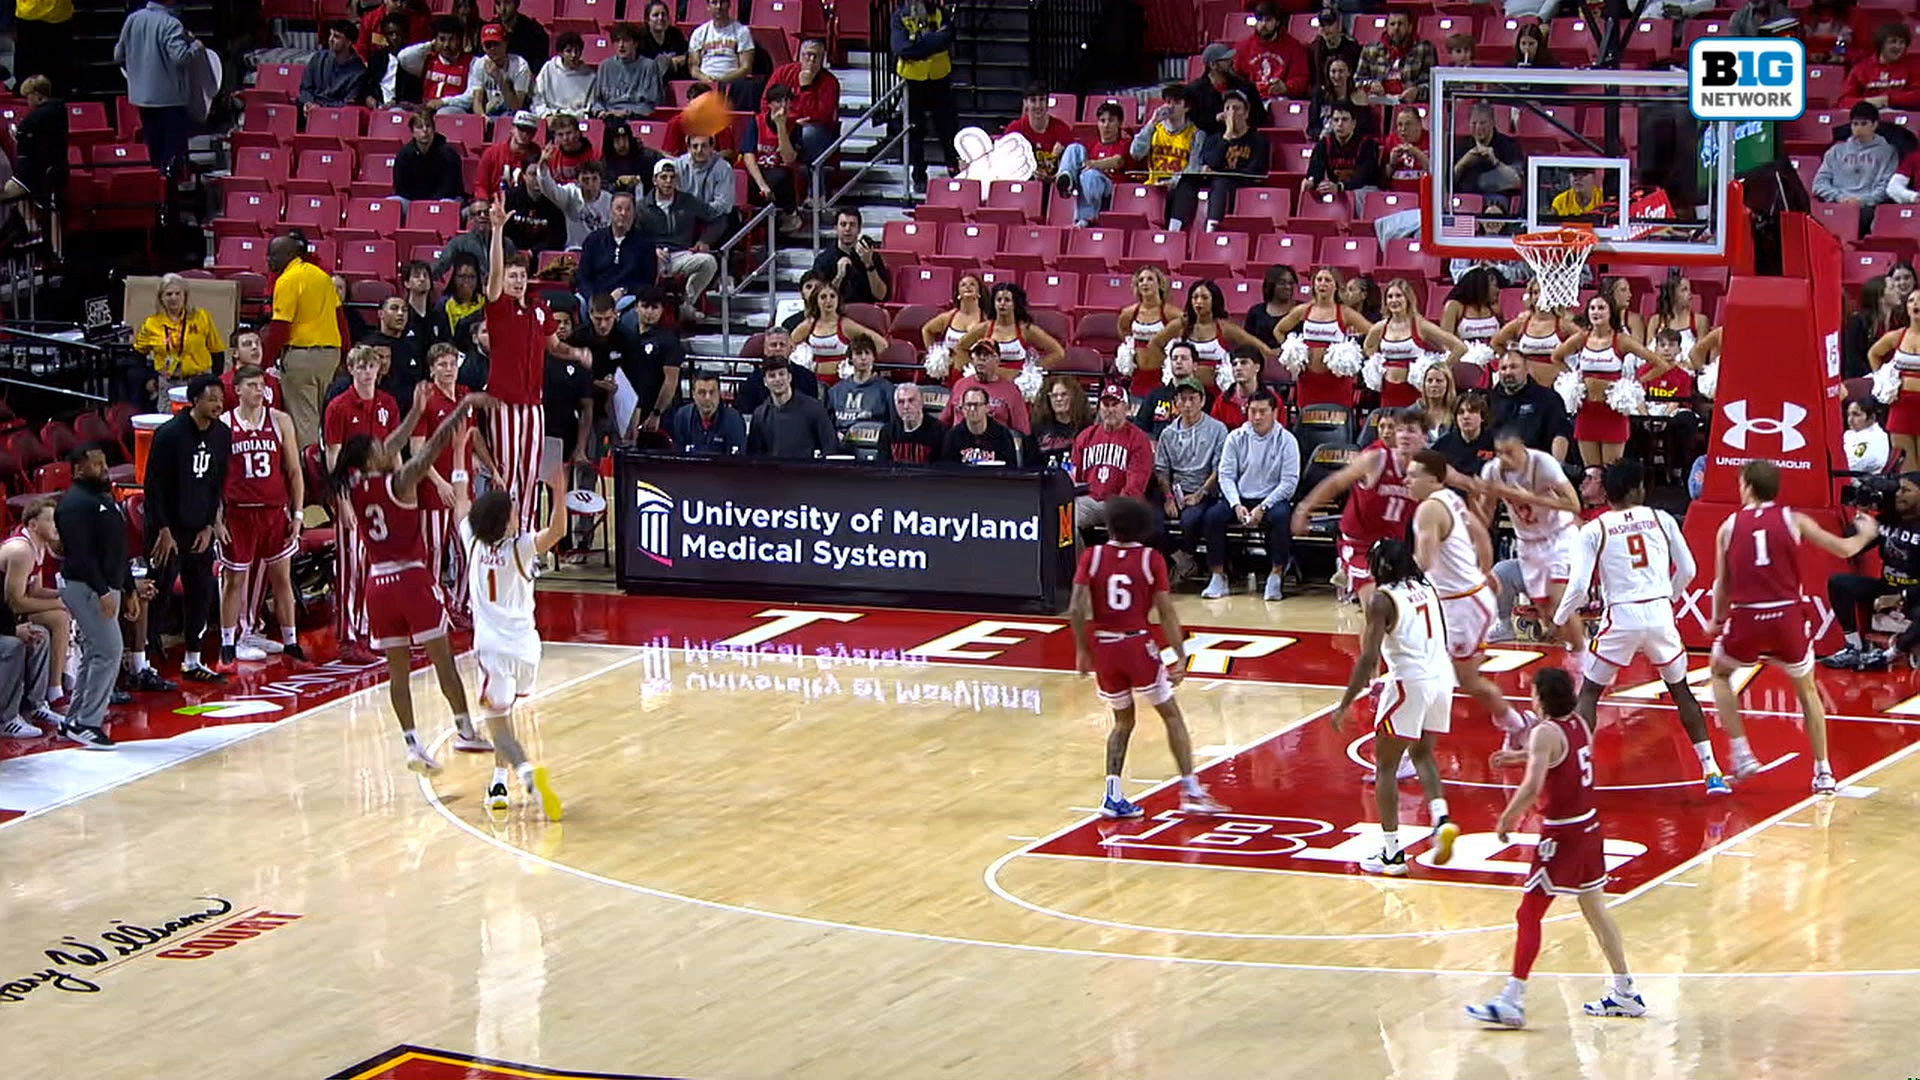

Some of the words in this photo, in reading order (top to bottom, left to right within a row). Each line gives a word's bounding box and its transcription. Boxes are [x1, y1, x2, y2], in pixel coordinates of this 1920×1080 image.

[231, 439, 277, 454] INDIANA
[1082, 442, 1128, 471] INDIANA
[243, 451, 272, 479] 13
[365, 503, 389, 541] 3
[682, 500, 840, 536] University
[850, 508, 883, 533] of
[893, 510, 1039, 542] Maryland
[1608, 520, 1657, 536] WASHINGTON
[682, 534, 802, 563] Medical
[813, 540, 927, 570] System
[1626, 533, 1649, 569] 9
[1752, 529, 1771, 566] 1
[487, 568, 497, 602] 1
[1107, 573, 1132, 611] 6
[1415, 603, 1432, 639] 7
[1577, 745, 1594, 787] 5
[155, 909, 304, 960] COURT
